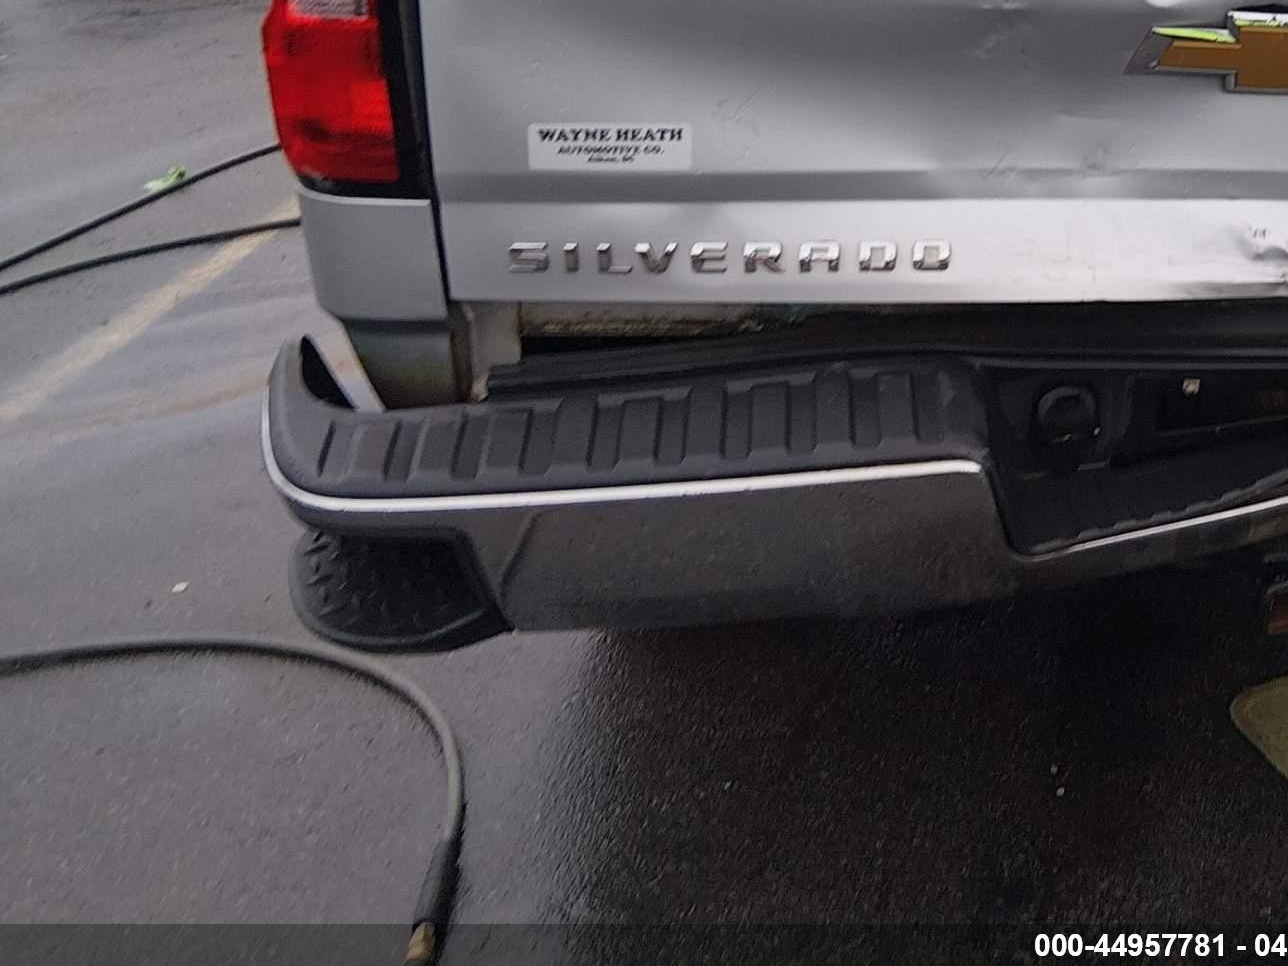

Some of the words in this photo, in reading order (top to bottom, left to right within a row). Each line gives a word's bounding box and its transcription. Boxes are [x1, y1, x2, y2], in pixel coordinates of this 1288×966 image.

[538, 128, 611, 142] WAYNE
[616, 128, 683, 142] HEATH
[508, 241, 951, 273] SILVERADO
